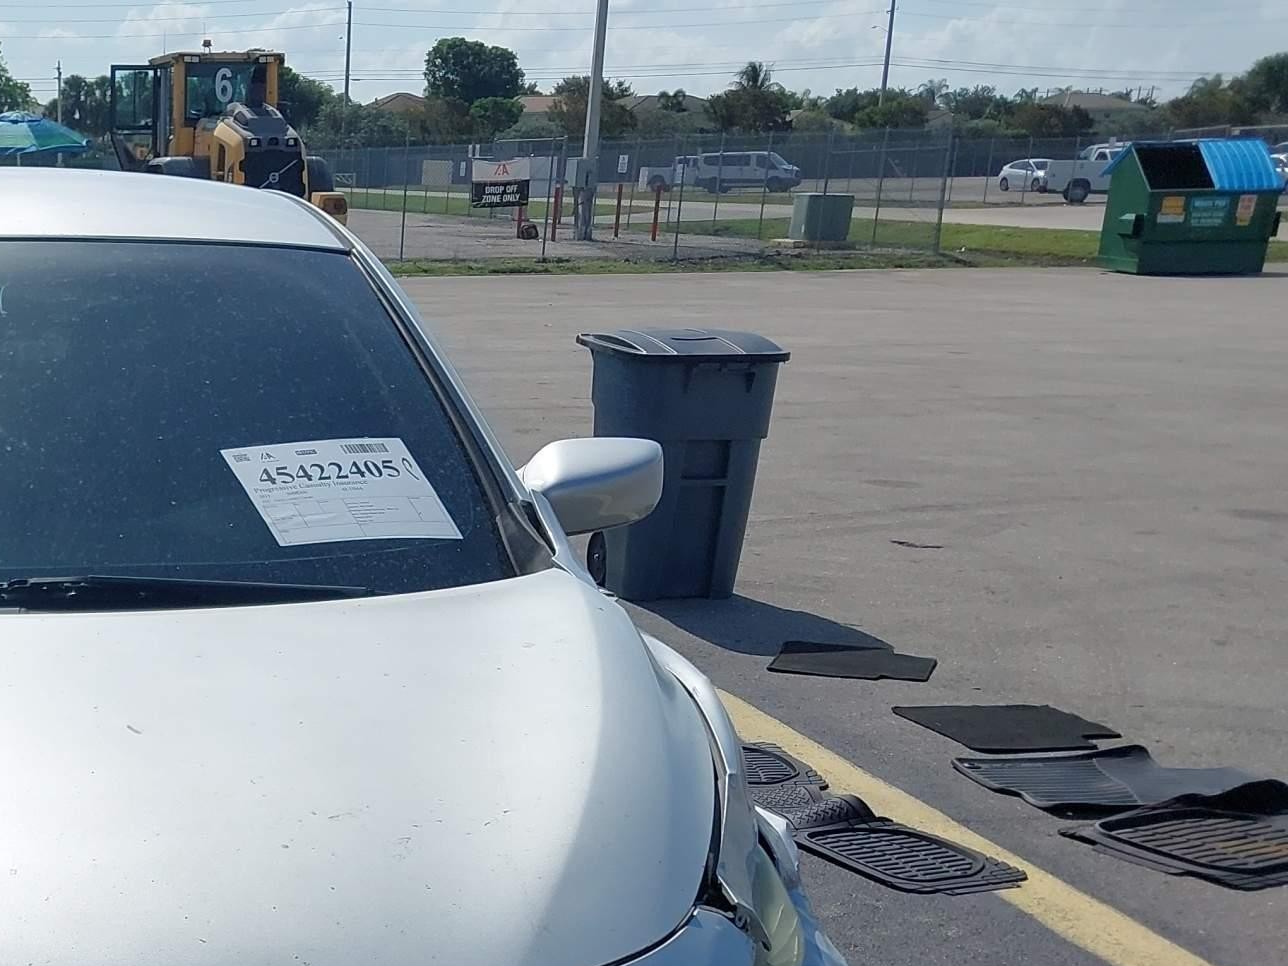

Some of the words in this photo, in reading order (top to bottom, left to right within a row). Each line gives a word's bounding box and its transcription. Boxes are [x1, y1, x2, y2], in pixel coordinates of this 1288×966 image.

[215, 67, 233, 103] 6
[482, 195, 502, 203] ZONE
[502, 194, 520, 202] ONLY
[485, 186, 504, 194] DROP
[505, 185, 518, 193] OFF
[259, 459, 401, 486] 45422405
